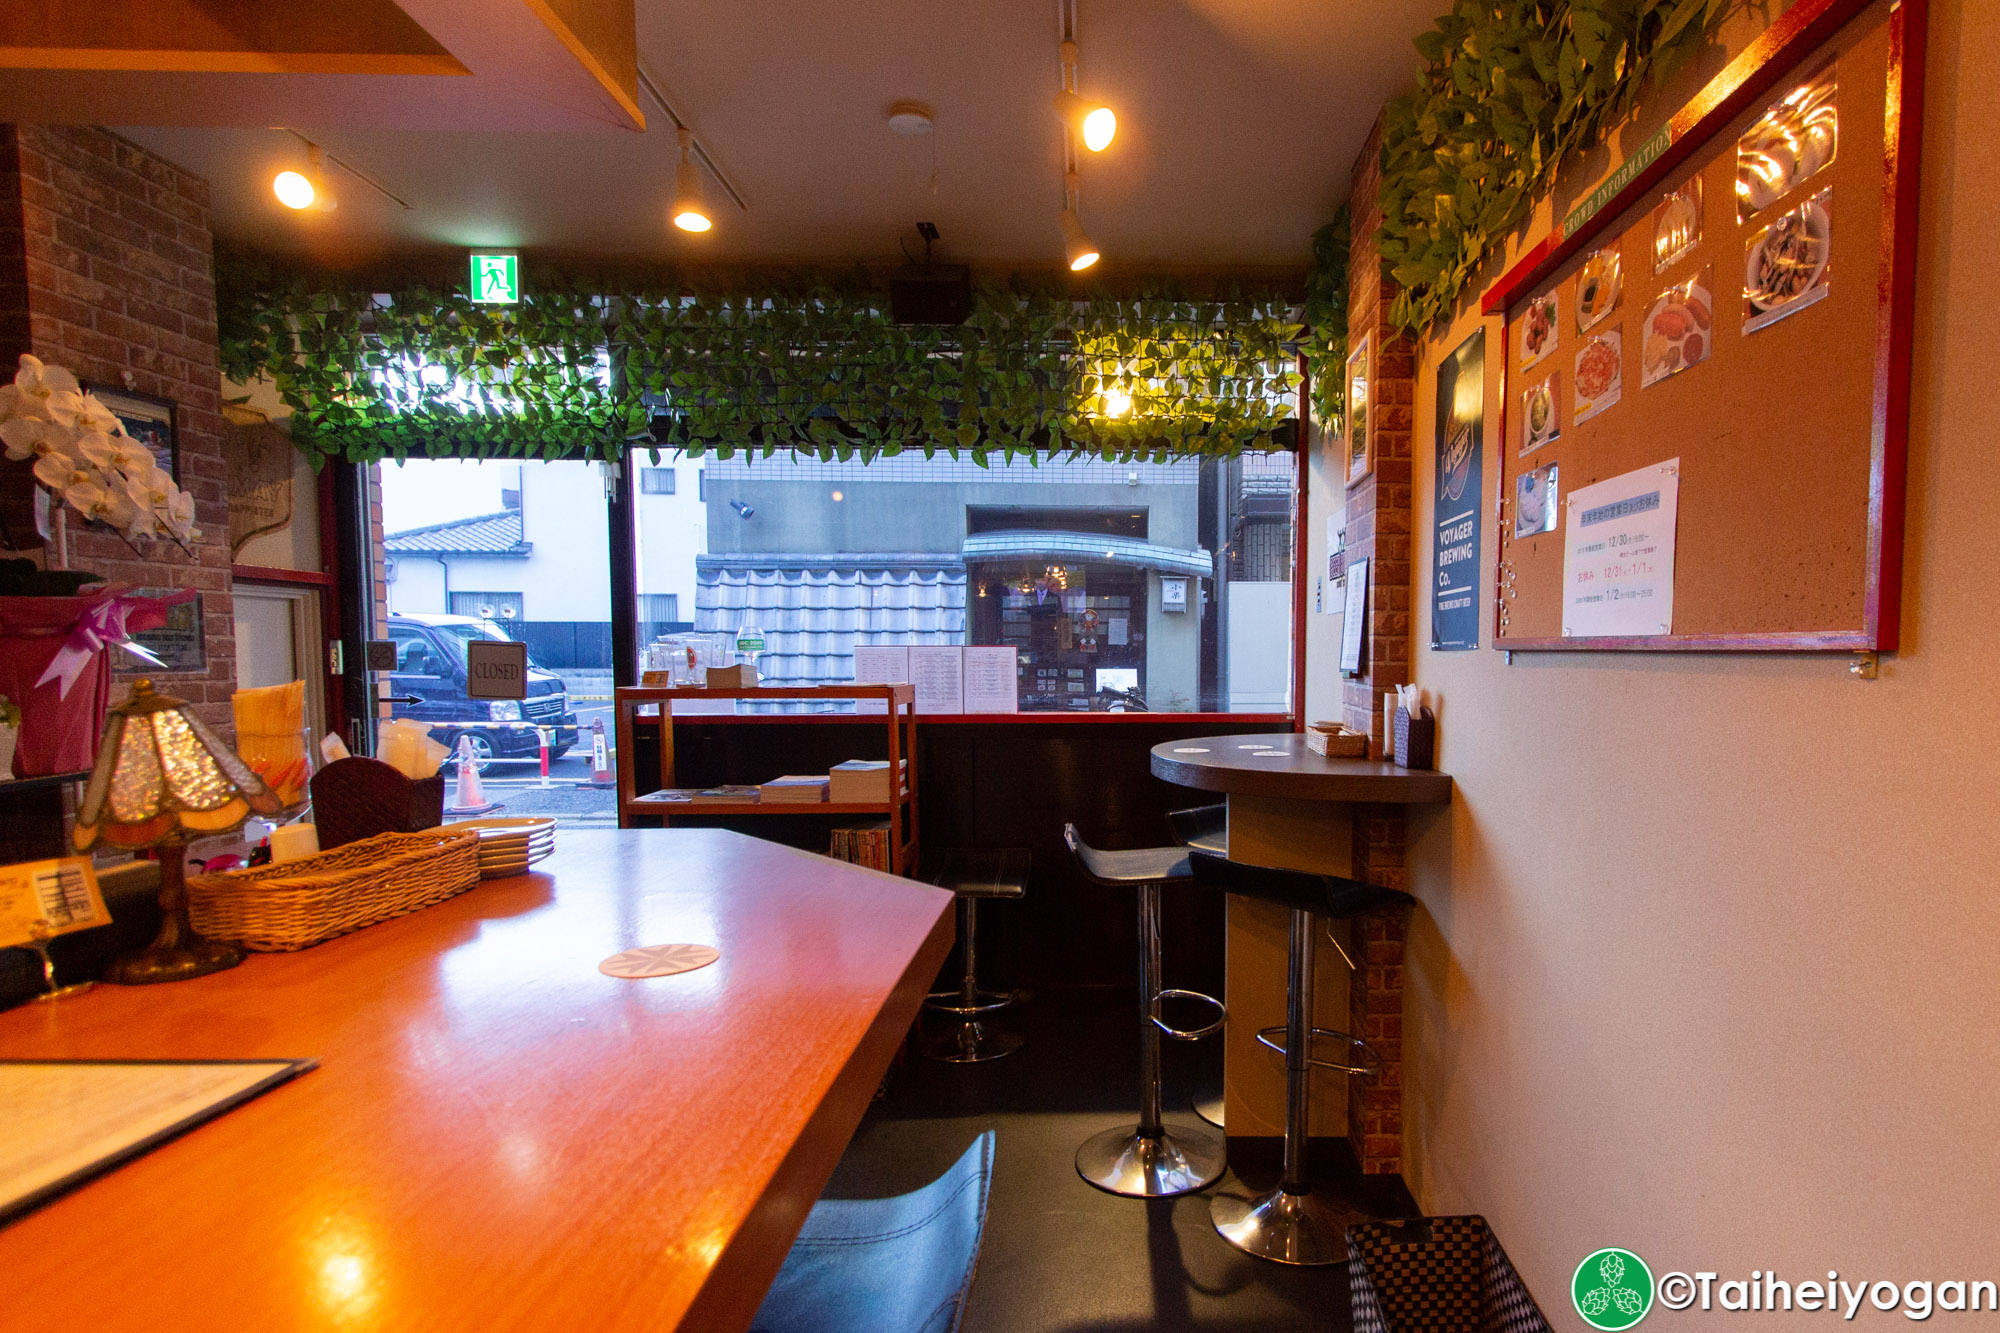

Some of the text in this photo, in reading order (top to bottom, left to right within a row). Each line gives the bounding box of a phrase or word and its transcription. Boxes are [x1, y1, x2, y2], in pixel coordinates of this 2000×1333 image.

[1564, 128, 1671, 236] CROWD INFORMATION
[1440, 520, 1473, 546] VOYAGER
[1440, 542, 1473, 567] BREWING
[1439, 571, 1451, 587] Co.
[1578, 571, 1595, 583] お休み
[475, 663, 519, 681] CLOSED
